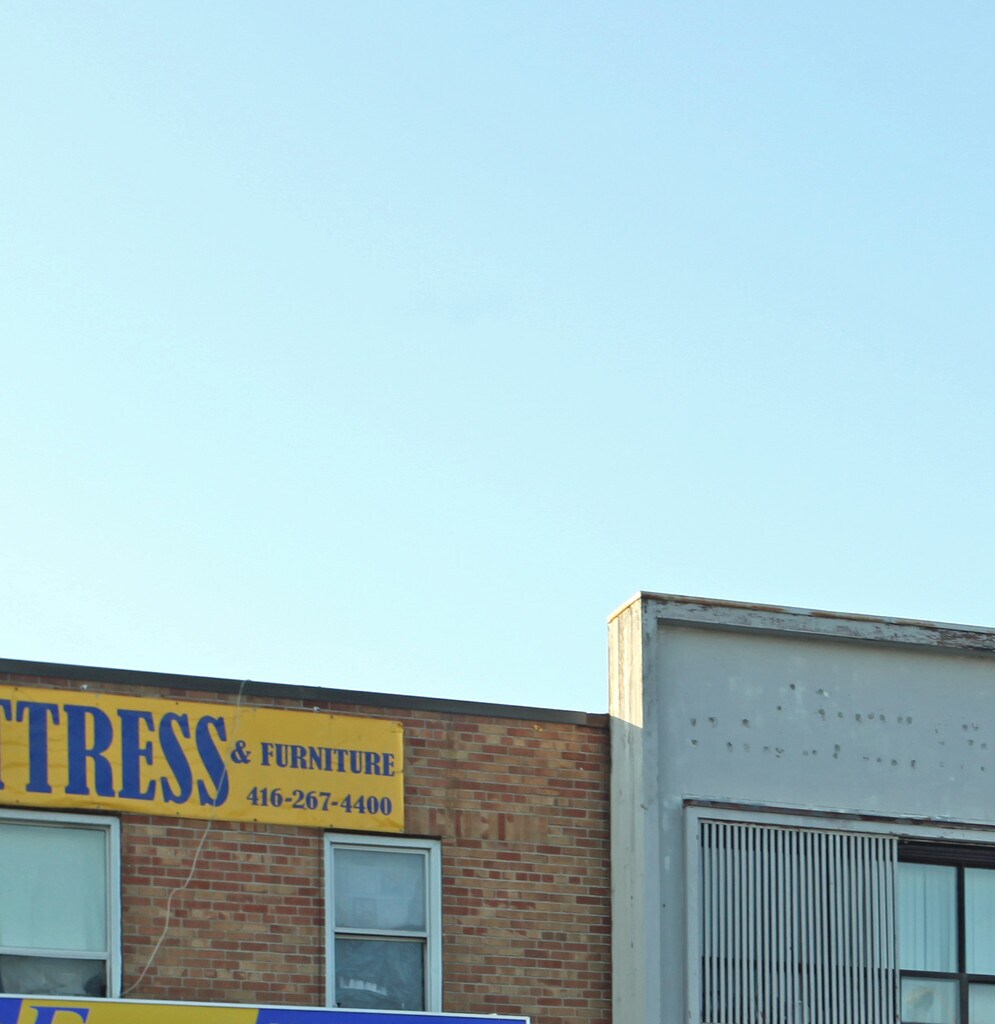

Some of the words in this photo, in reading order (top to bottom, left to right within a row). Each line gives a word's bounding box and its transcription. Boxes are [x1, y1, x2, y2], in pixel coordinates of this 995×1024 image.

[230, 740, 251, 764] &
[260, 742, 396, 777] FURNITURE
[246, 786, 393, 816] 416-267-4400
